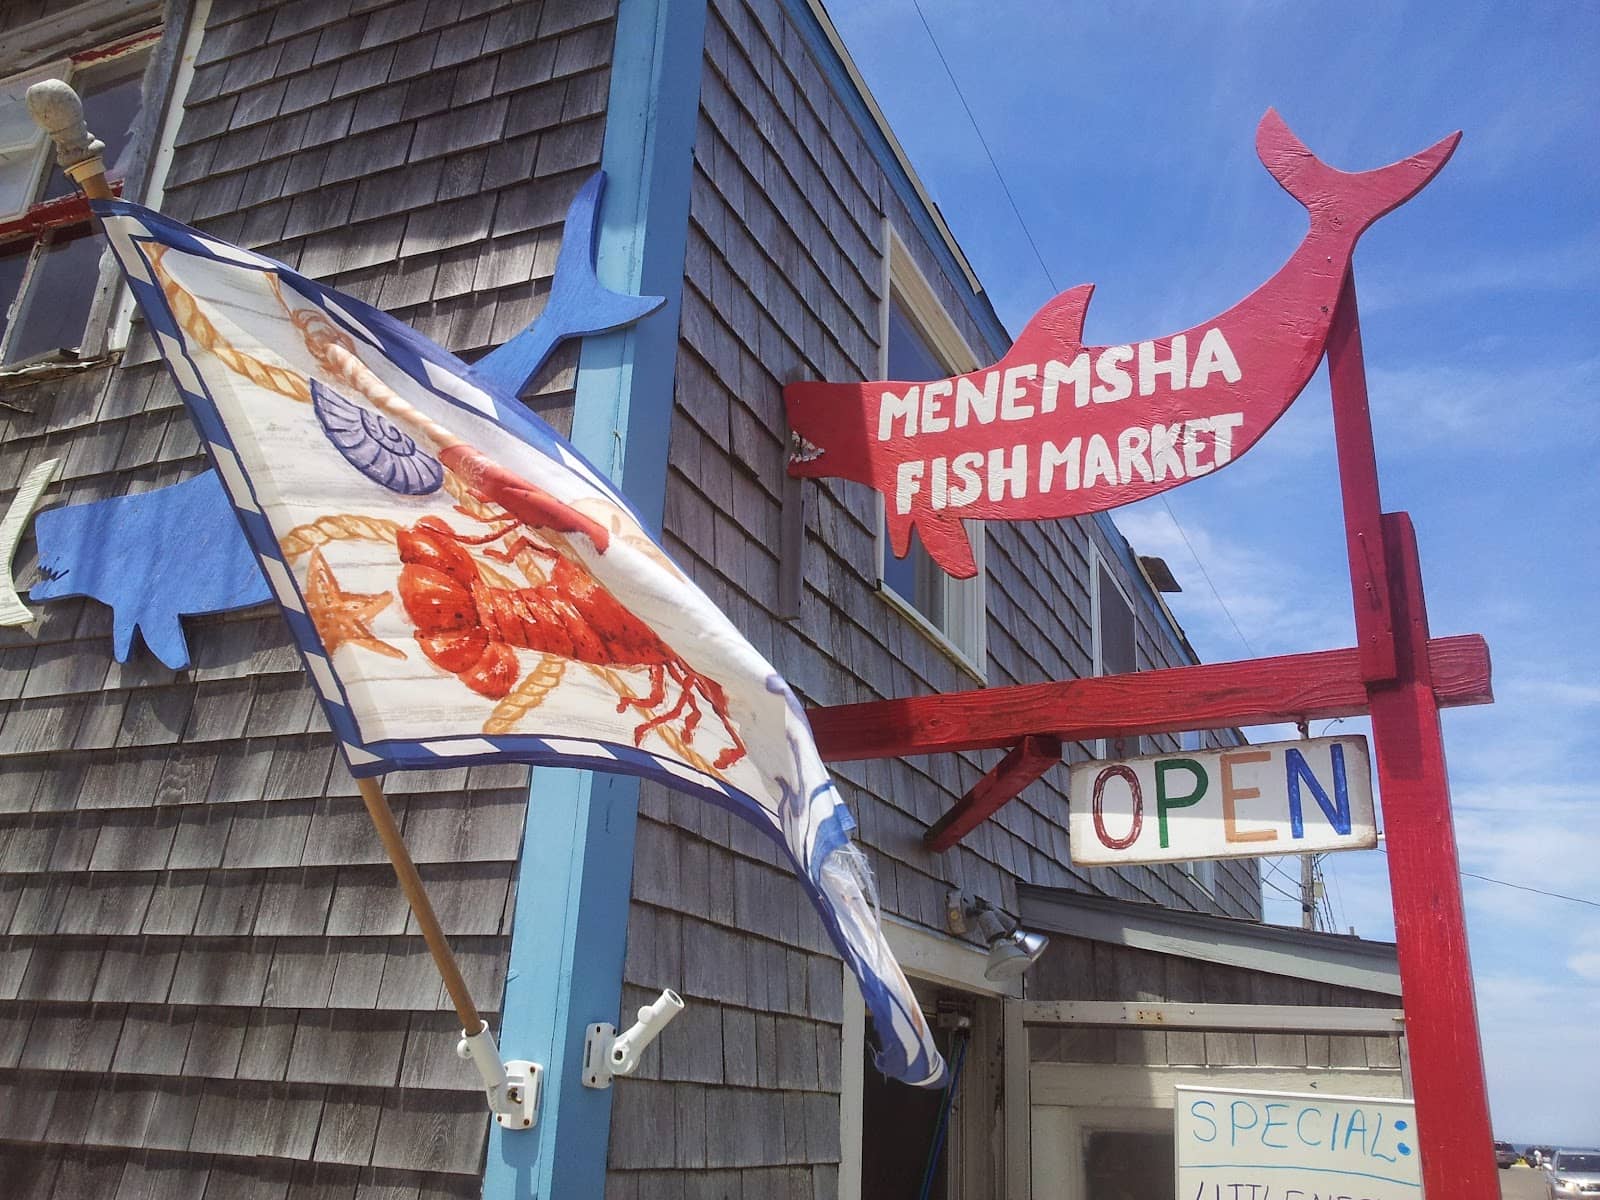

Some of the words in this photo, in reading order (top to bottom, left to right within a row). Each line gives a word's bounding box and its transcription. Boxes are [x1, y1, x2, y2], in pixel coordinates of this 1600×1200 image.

[878, 328, 1242, 441] MENEMSHA
[896, 444, 1027, 515] FISH
[1039, 412, 1243, 493] MARKET
[1092, 743, 1352, 850] OPEN
[1191, 1100, 1411, 1162] SPECIAL:
